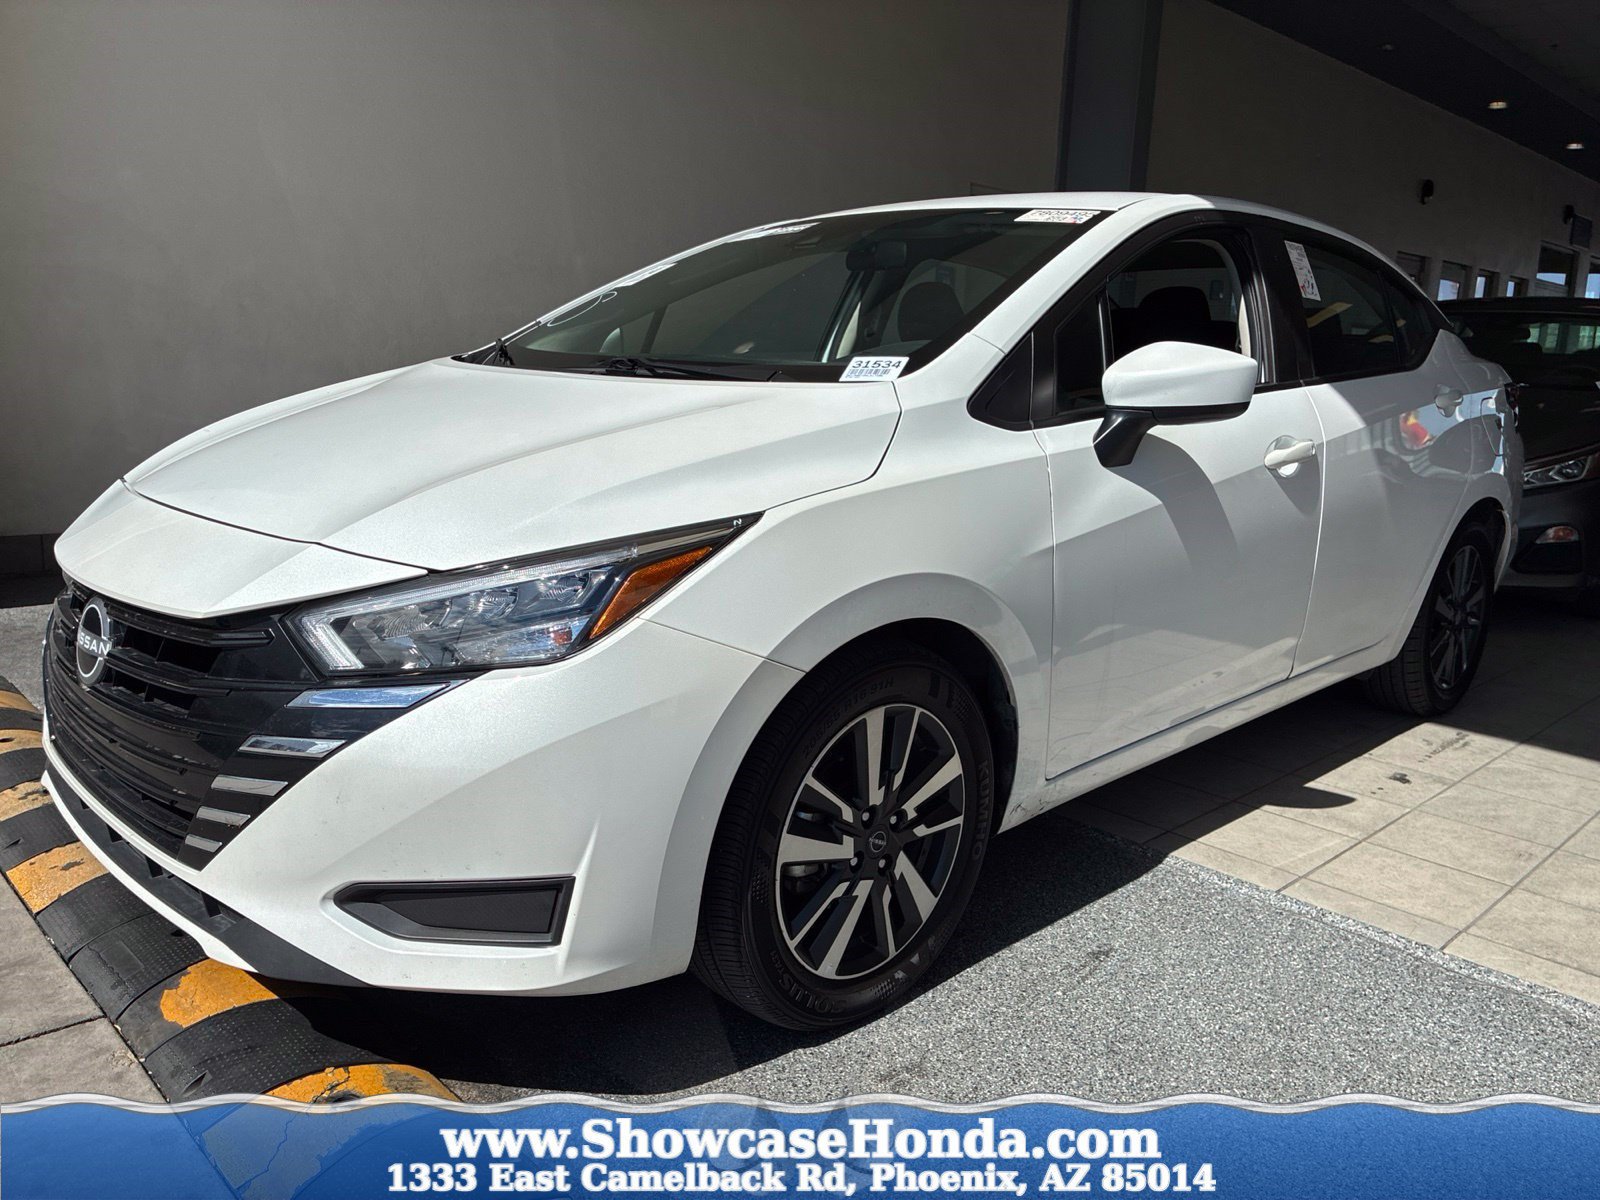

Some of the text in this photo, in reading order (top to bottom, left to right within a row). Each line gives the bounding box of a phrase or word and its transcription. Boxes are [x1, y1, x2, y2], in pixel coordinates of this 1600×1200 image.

[852, 360, 902, 369] 31534
[79, 632, 110, 656] SSAN
[971, 760, 990, 861] KUMHO
[779, 973, 844, 1014] SOLUS
